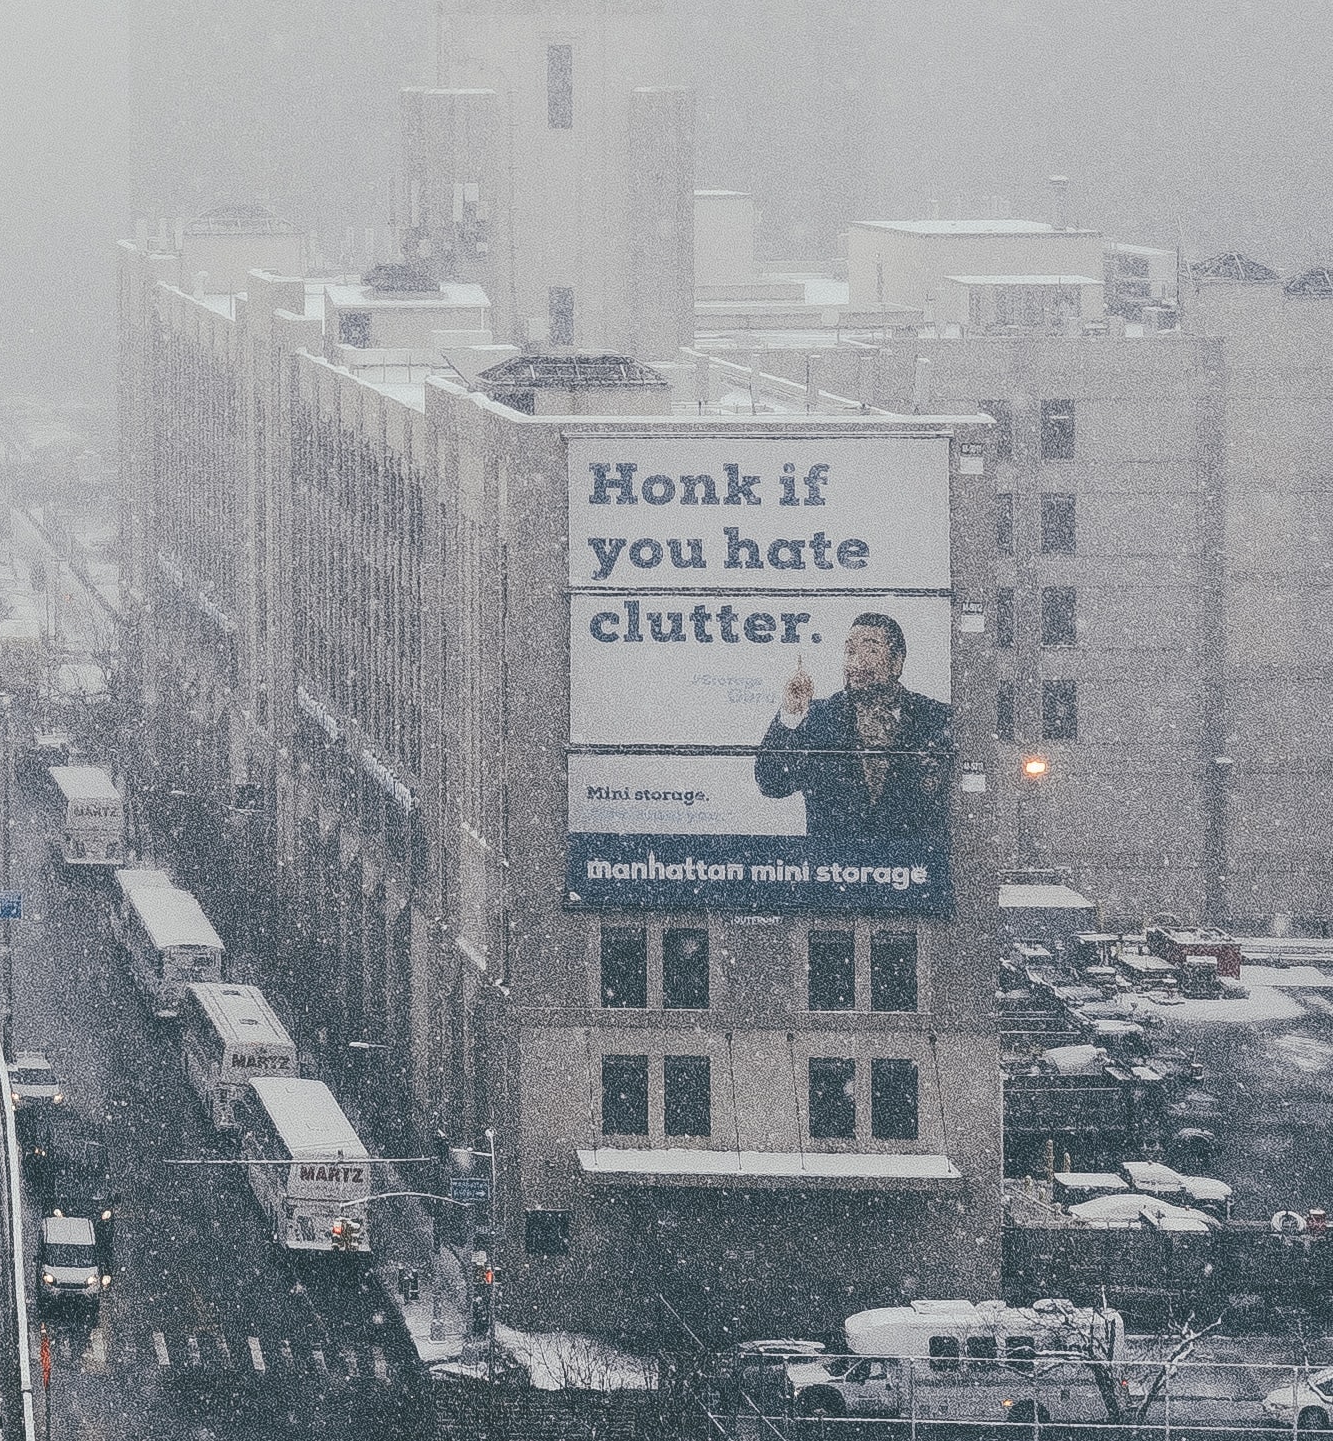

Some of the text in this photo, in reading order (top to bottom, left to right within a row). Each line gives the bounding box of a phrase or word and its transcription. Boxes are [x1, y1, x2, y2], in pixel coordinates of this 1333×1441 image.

[588, 462, 831, 507] Honk if
[587, 526, 871, 580] you hate
[589, 600, 823, 644] clutter.
[586, 785, 710, 807] Mini storage.
[586, 850, 929, 891] manhattan mini storage
[231, 1053, 290, 1070] MARTZ
[299, 1165, 364, 1184] MARTZ
